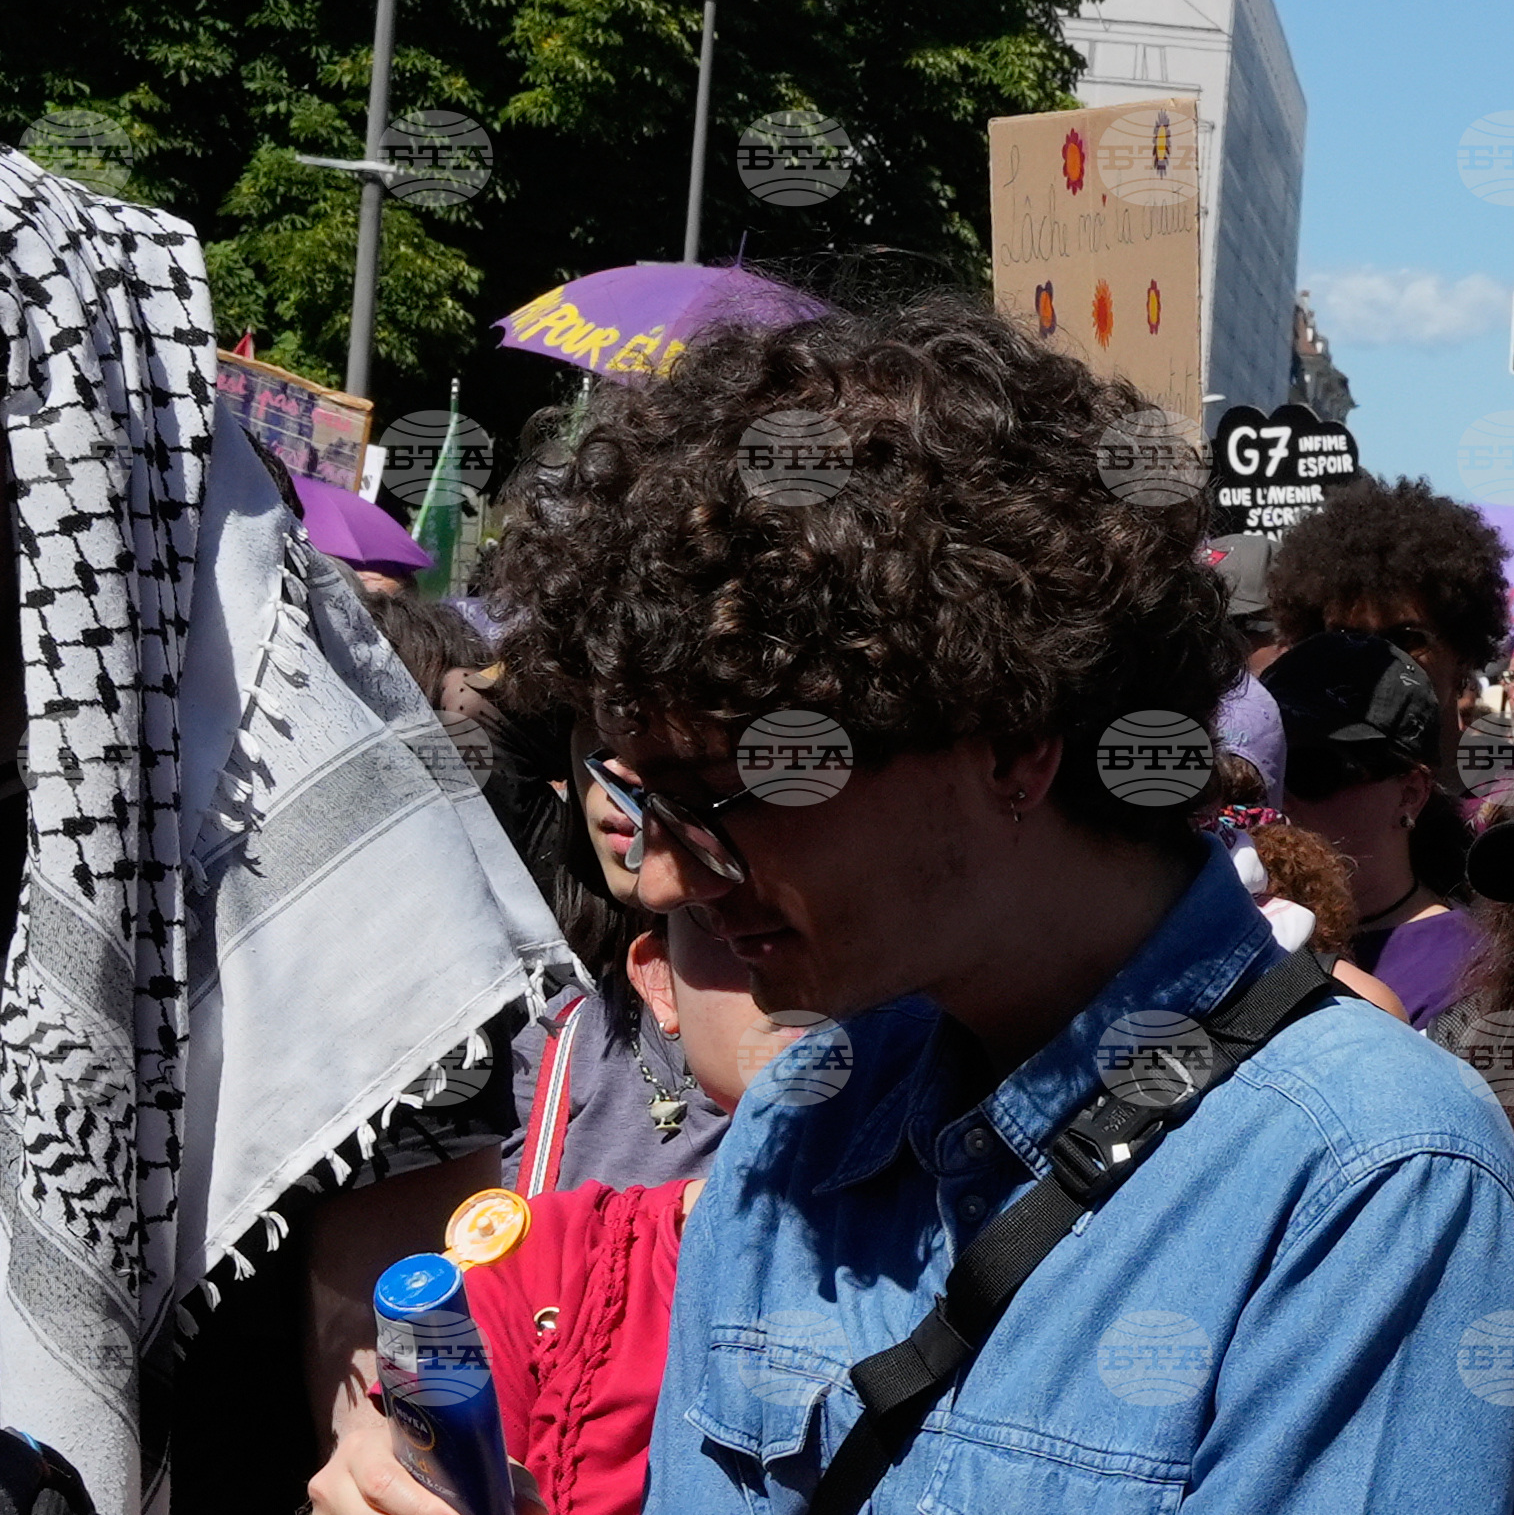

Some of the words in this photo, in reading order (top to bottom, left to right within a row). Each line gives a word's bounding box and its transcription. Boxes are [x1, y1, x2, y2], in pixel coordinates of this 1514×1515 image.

[518, 302, 620, 370] POUR
[1228, 426, 1292, 477] G7
[1299, 435, 1348, 453] INFIME
[1298, 454, 1354, 477] ESPOIR
[1219, 487, 1252, 506] QUE
[1256, 484, 1325, 505] L'AVENIR
